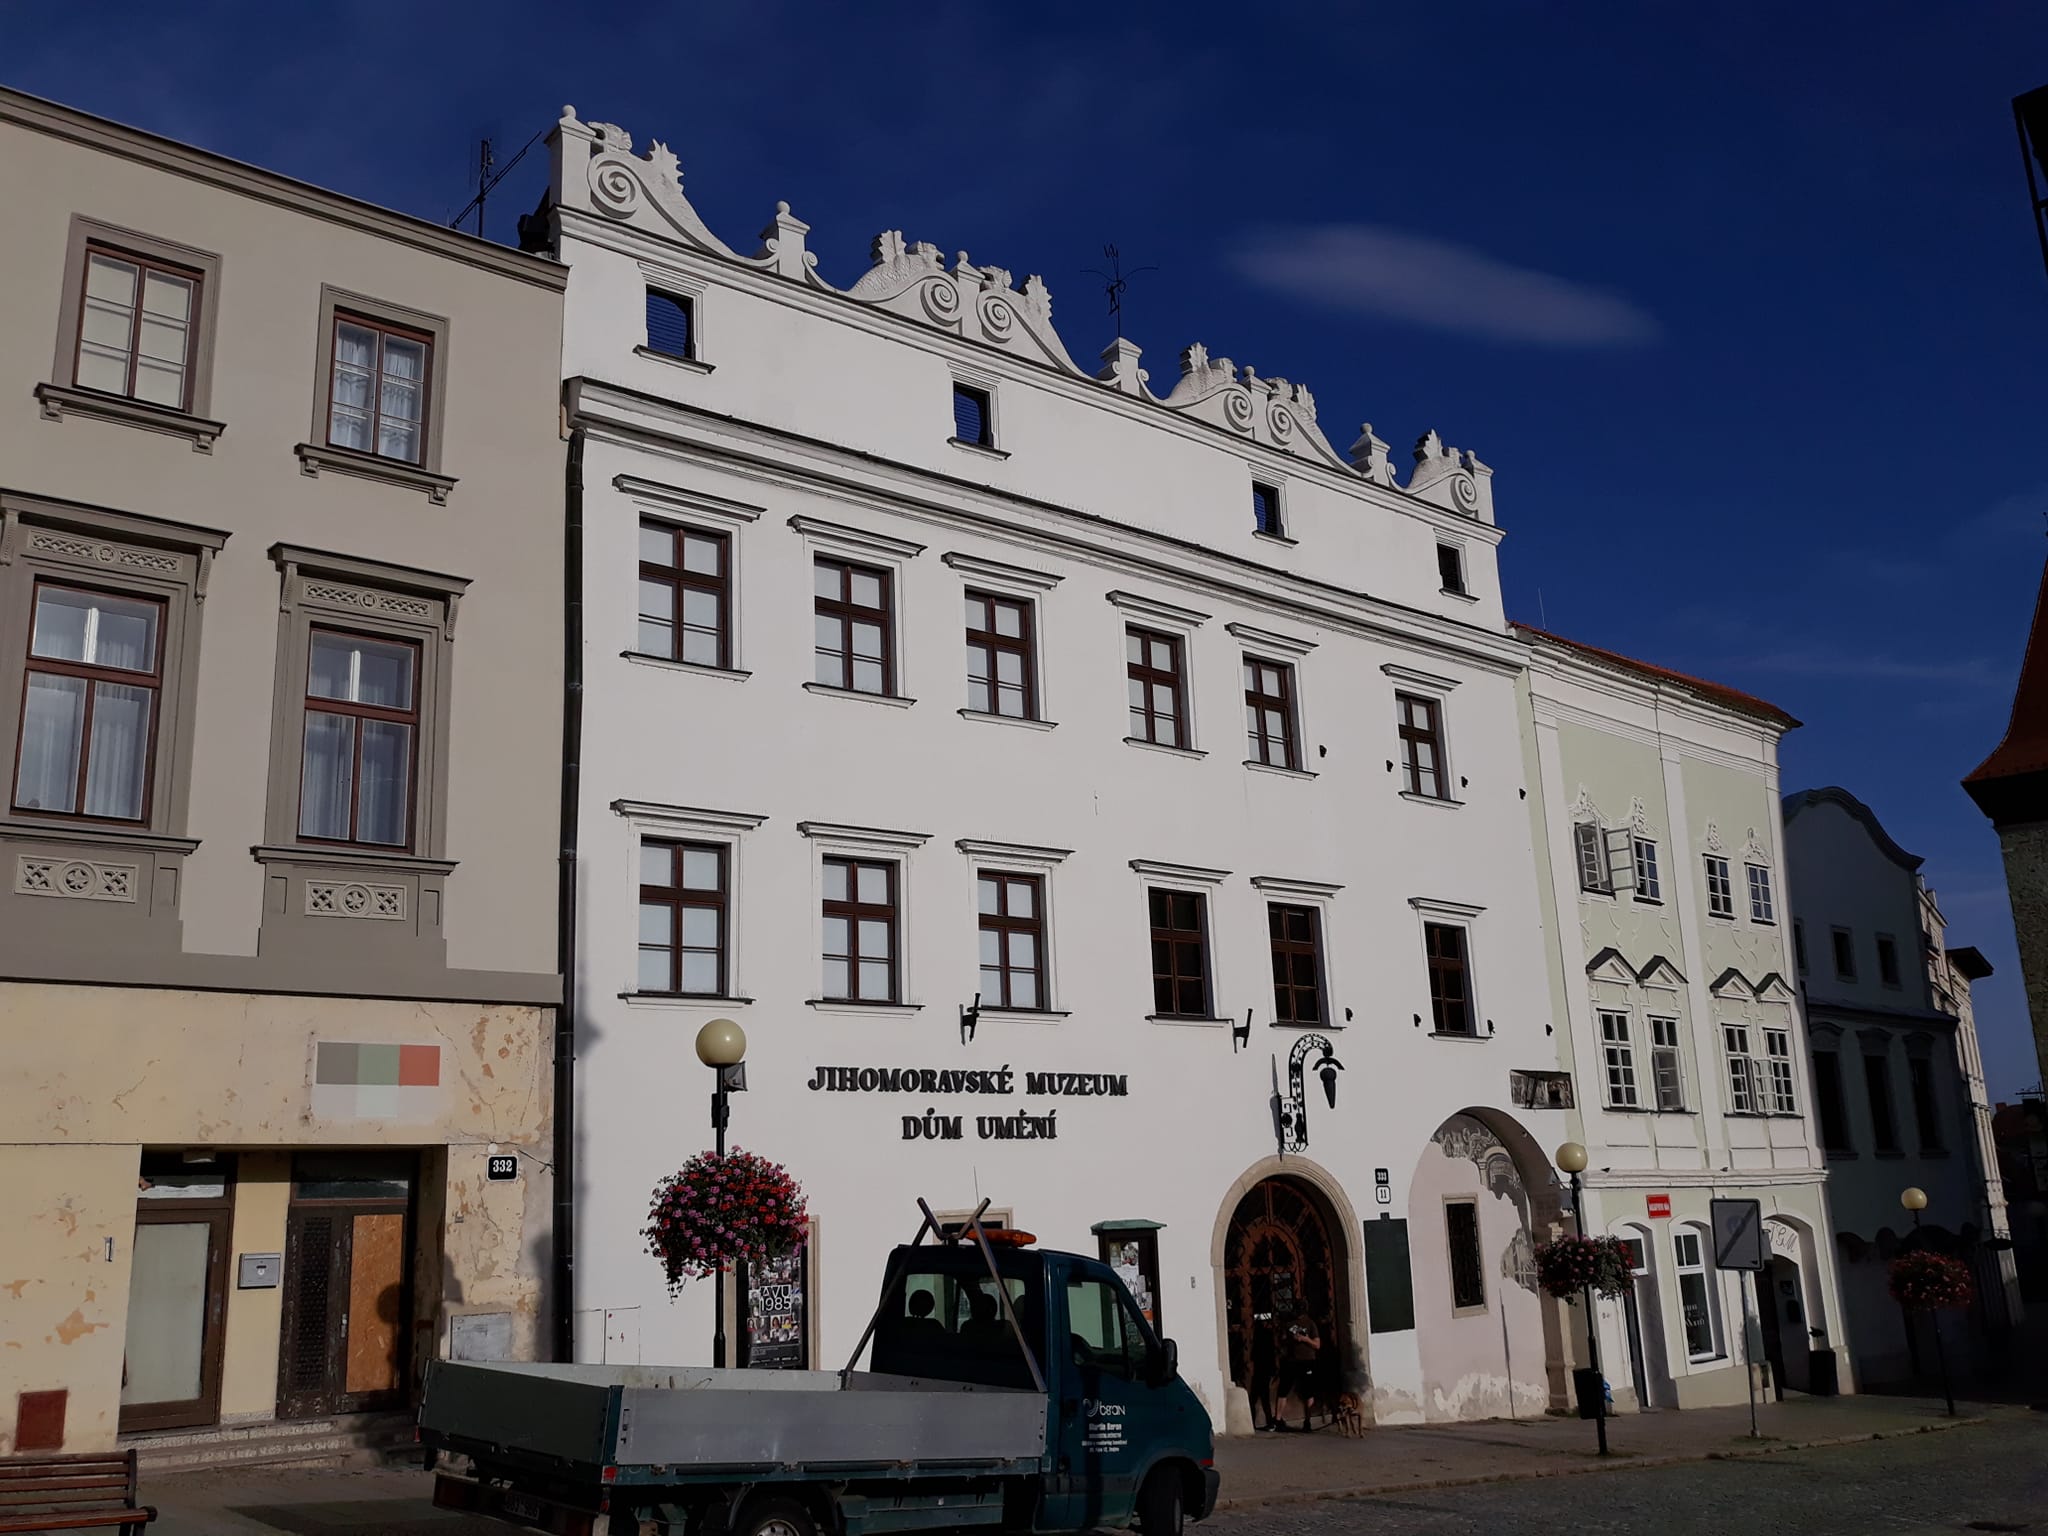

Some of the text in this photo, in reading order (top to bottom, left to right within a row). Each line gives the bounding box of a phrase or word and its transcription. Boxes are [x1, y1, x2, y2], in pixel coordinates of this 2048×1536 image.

[807, 1064, 1128, 1096] JIHOMORAVSKÉ MUZEUM
[902, 1107, 1058, 1140] DŮM UMĚNÍ
[492, 1159, 513, 1173] 332
[1376, 1171, 1387, 1181] 333
[1380, 1189, 1387, 1199] 11
[762, 1285, 791, 1298] AVU
[760, 1297, 791, 1311] 1985
